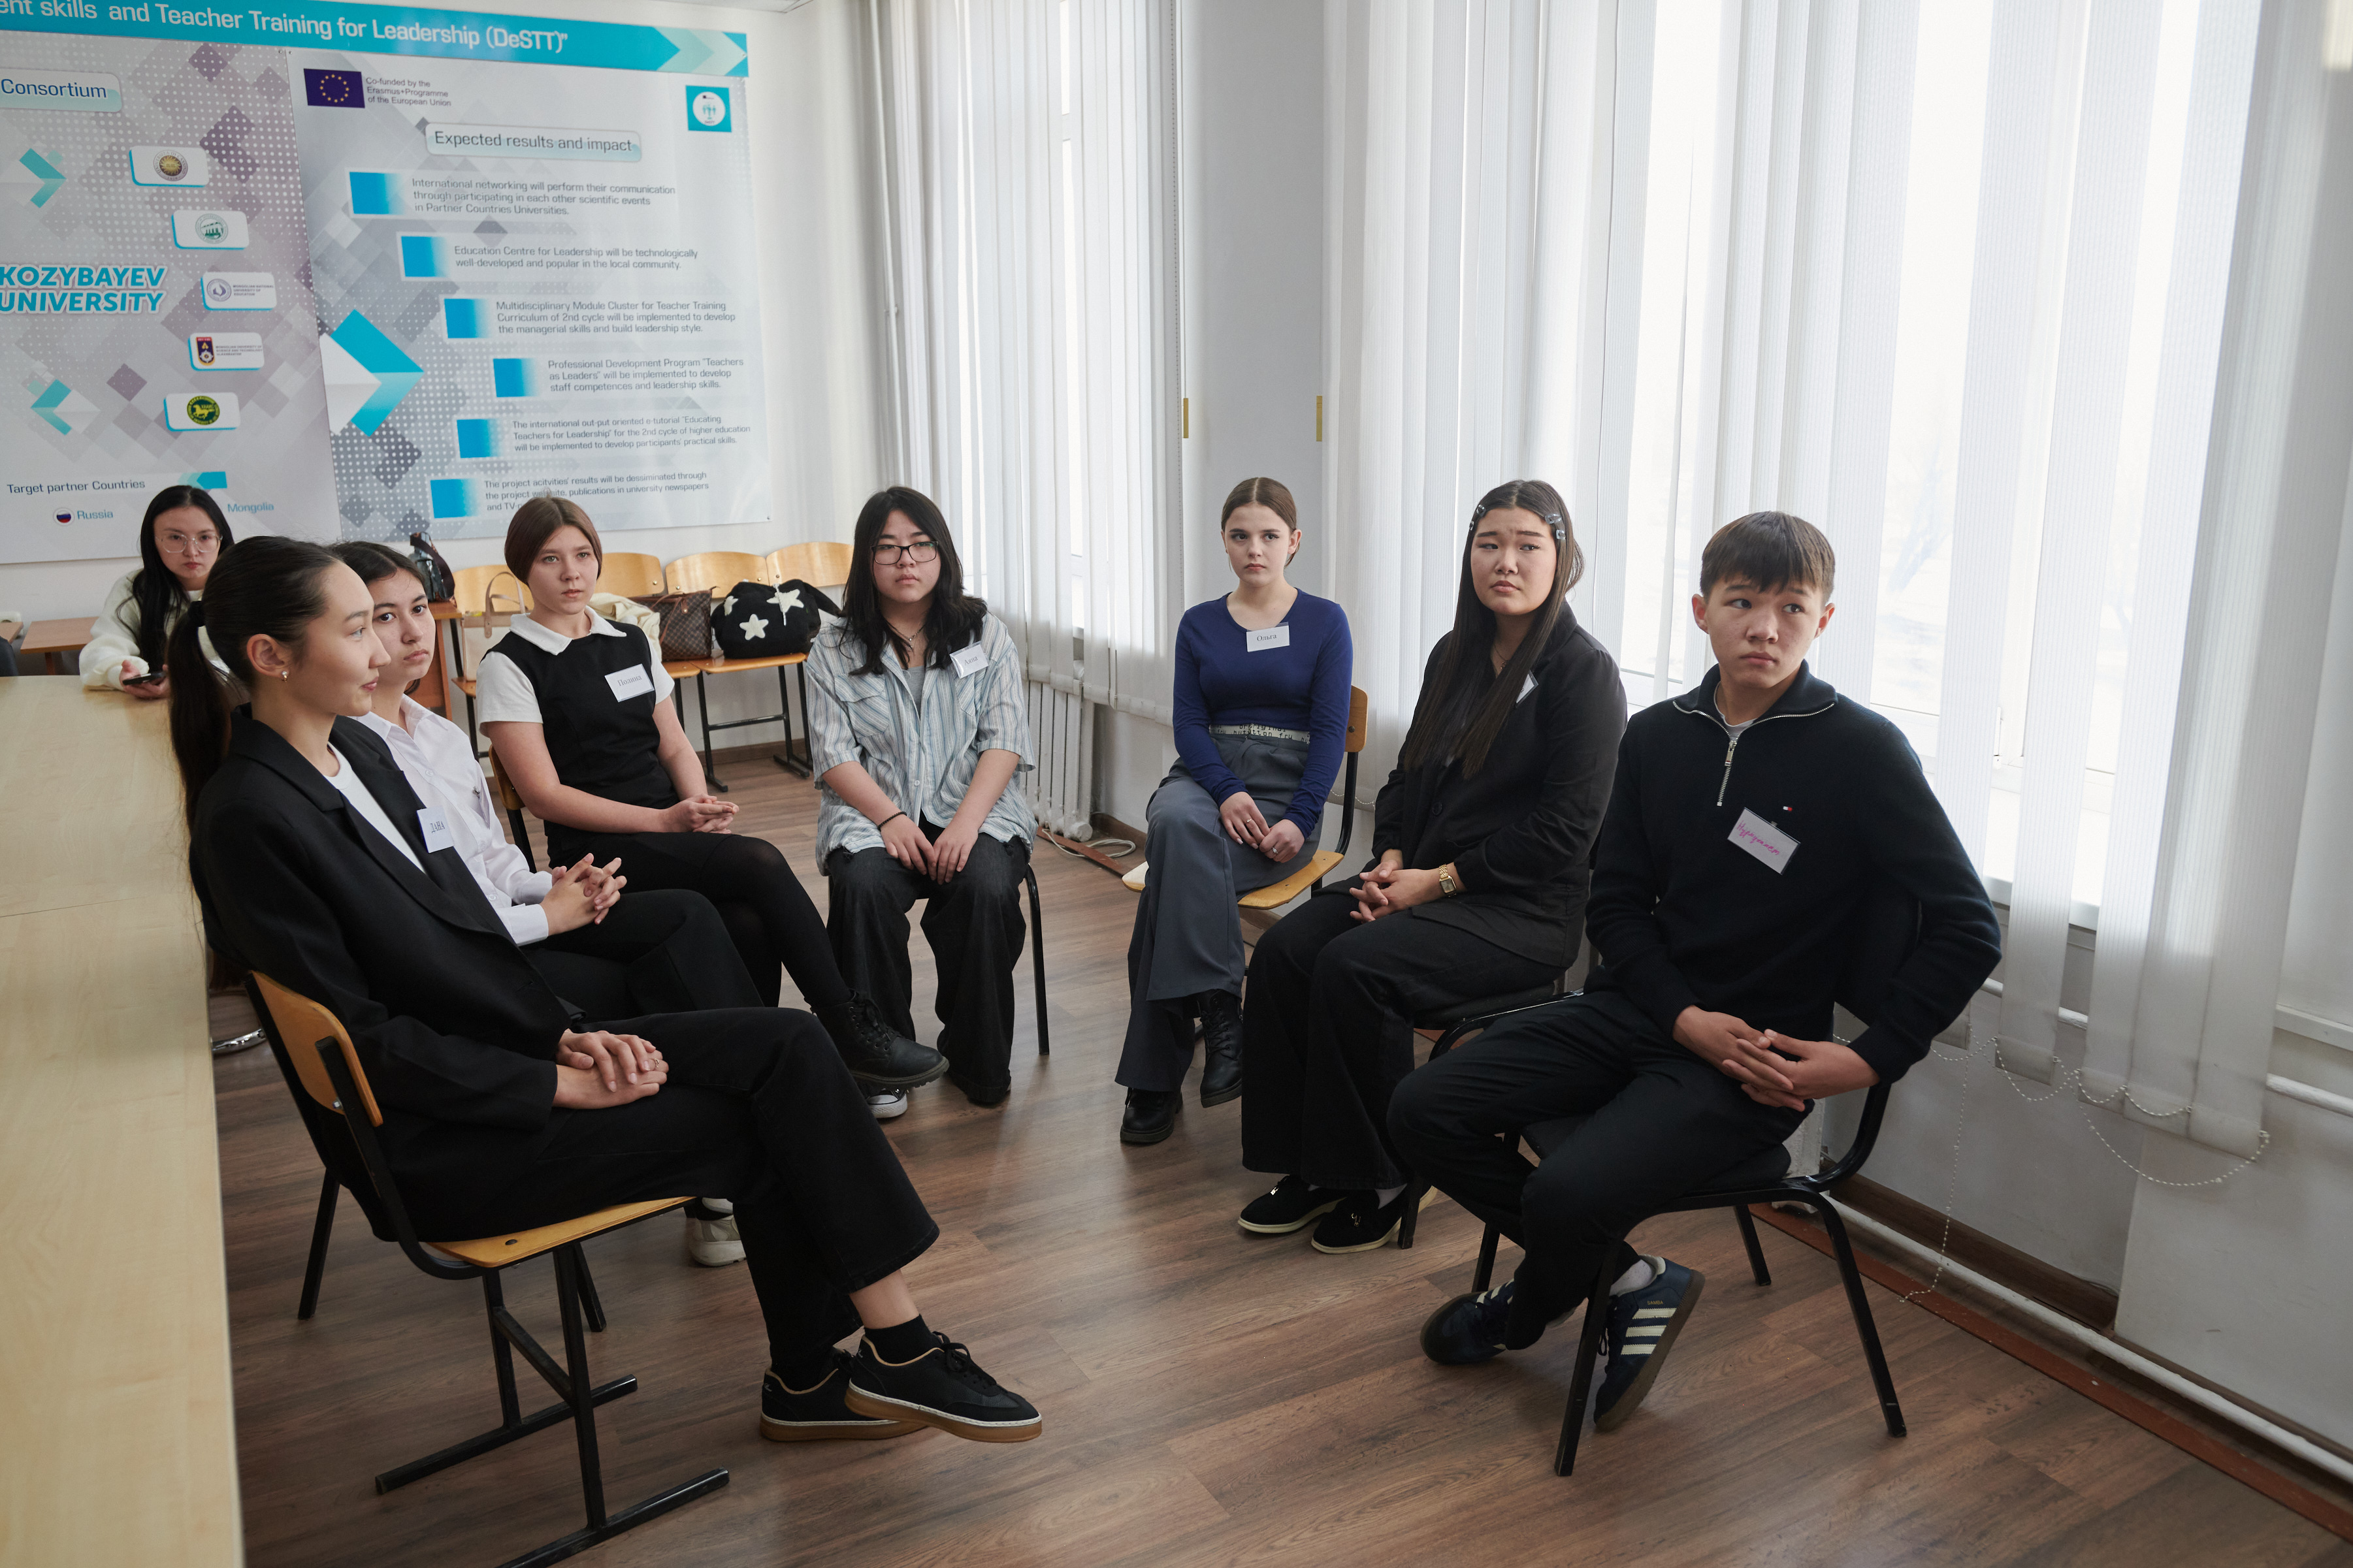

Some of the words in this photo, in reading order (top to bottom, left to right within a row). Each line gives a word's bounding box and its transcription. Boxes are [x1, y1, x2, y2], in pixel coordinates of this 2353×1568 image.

[40, 0, 97, 19] skills
[108, 2, 150, 22] and
[155, 3, 243, 28] Teacher
[249, 10, 333, 40] Training
[337, 17, 366, 37] for
[372, 20, 479, 48] Leadership
[366, 77, 406, 86] Co-funded
[1, 78, 108, 99] Consortium
[391, 96, 428, 105] European
[435, 131, 501, 147] Expected
[506, 136, 553, 148] results
[558, 137, 583, 149] and
[587, 138, 631, 153] impact
[412, 178, 472, 188] International
[475, 181, 527, 191] networking
[530, 182, 544, 190] will
[547, 182, 584, 192] perform
[586, 184, 607, 192] their
[414, 191, 451, 202] through
[454, 193, 513, 203] participating
[515, 193, 524, 201] in
[579, 195, 619, 204] scientific
[415, 202, 423, 211] in
[426, 202, 462, 212] Partner
[466, 204, 511, 213] Countries
[454, 246, 501, 255] Education
[503, 246, 535, 255] Centre
[538, 247, 551, 255] for
[553, 248, 603, 257] Leadership
[635, 249, 698, 259] technologically
[527, 259, 544, 267] and
[546, 259, 579, 269] popular
[583, 259, 591, 268] in
[593, 259, 608, 268] the
[610, 259, 630, 268] local
[0, 266, 165, 286] KOZYBAYEV
[0, 292, 163, 312] UNIVERSITY
[496, 301, 570, 311] Multidisciplinary
[572, 301, 605, 310] Module
[608, 301, 639, 310] Cluster
[641, 301, 654, 310] for
[657, 301, 690, 310] Teacher
[693, 301, 726, 311] Training
[497, 313, 548, 321] Curriculum
[550, 312, 559, 321] of
[562, 312, 579, 321] 2nd
[581, 313, 604, 323] cycle
[636, 313, 690, 322] implemented
[704, 312, 736, 321] develop
[516, 325, 566, 334] managerial
[611, 324, 632, 332] build
[635, 324, 679, 333] leadership
[548, 360, 603, 368] Professional
[606, 359, 661, 368] Development
[664, 358, 700, 368] Program
[632, 370, 687, 379] implemented
[700, 369, 731, 377] develop
[550, 383, 570, 391] staff
[574, 383, 632, 392] competences
[653, 381, 696, 389] leadership
[658, 428, 677, 436] cycle
[689, 426, 712, 435] higher
[542, 442, 592, 451] implemented
[683, 437, 715, 446] practical
[502, 479, 530, 488] project
[677, 472, 707, 480] through
[7, 484, 46, 495] Target
[47, 482, 89, 494] partner
[92, 480, 146, 490] Countries
[501, 491, 530, 500] project
[569, 488, 615, 496] publications
[227, 502, 274, 515] Mongolia
[77, 510, 114, 520] Russia
[617, 675, 642, 686] Полина
